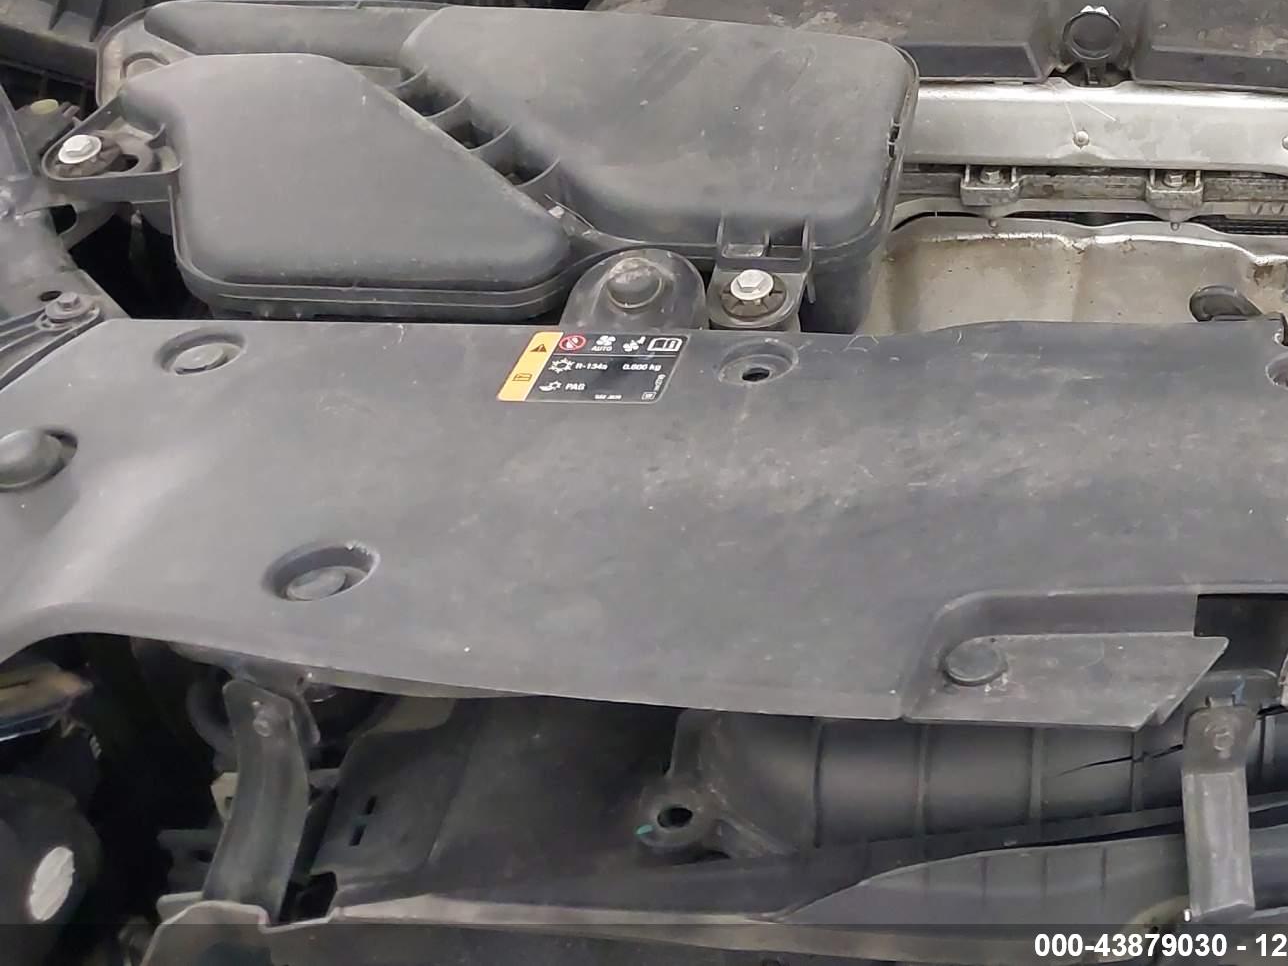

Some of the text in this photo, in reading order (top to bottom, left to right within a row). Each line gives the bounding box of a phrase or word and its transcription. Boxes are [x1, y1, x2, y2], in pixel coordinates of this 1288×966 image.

[575, 362, 608, 370] R-134a
[649, 363, 662, 372] kg
[565, 382, 586, 390] PAG
